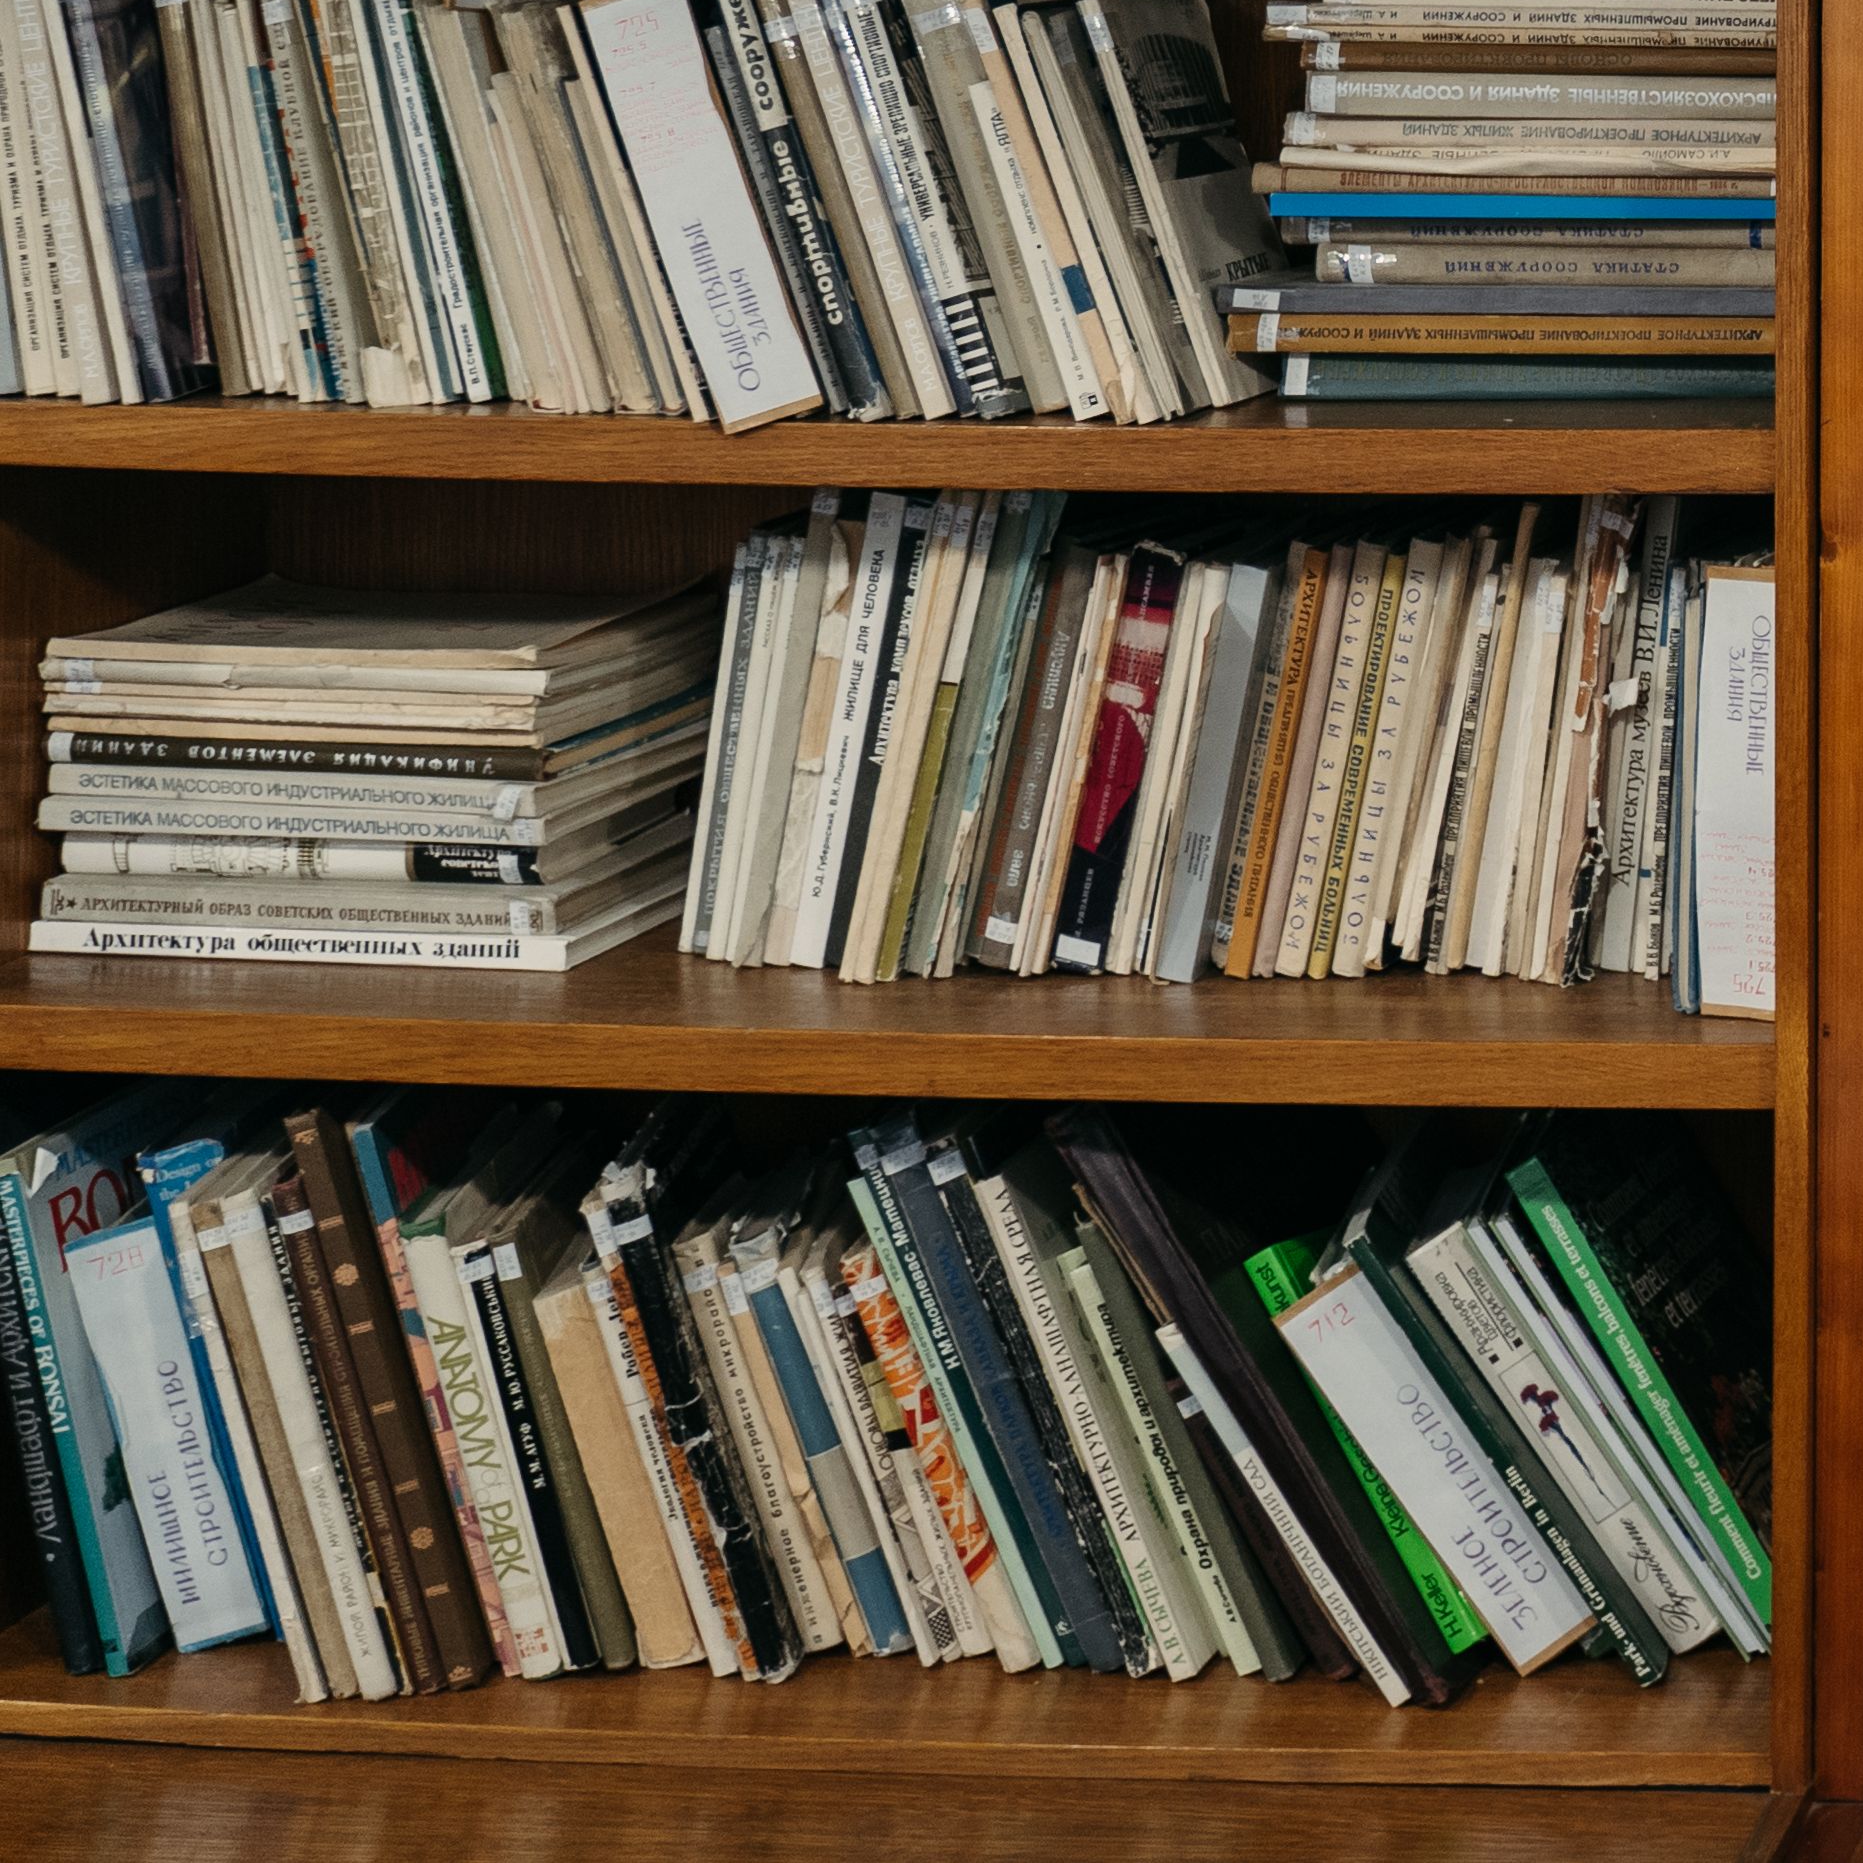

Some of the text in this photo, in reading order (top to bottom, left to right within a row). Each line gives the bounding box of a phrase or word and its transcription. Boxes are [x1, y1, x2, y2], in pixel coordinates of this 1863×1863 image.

[680, 215, 763, 396] ОБЩЕСТВЕННЫЕ
[727, 265, 772, 349] ЗДАНИЯ
[842, 548, 885, 721] ЖИЛИЩЕ ДЛЯ ЧЕЛОВЕКА
[1313, 588, 1394, 954] ПРОЕКТИРОВАНИЕ СОВРЕМЕННЫХ БОЛЬНИЦ
[70, 809, 510, 842] ЭСТЕТИКА МАССОВОГО ИНДУСТРИАЛЬНОГО ЖИЛИЩА
[1612, 748, 1647, 885] Архитектура
[80, 895, 203, 916] АРХИТЕКТУРНЫЙ
[209, 902, 252, 916] ОБРАЗ
[258, 905, 331, 920] СОВЕТСКИХ
[339, 908, 450, 926] ОБЩЕСТВЕННЫХ
[84, 928, 520, 959] Архитектура общественных зданий
[1539, 1203, 1582, 1265] terrasses
[1575, 1263, 1591, 1280] et
[1580, 1277, 1620, 1334] balcons
[0, 1179, 39, 1310] MASTERPIECES
[33, 1344, 70, 1434] BONSAI
[1307, 1302, 1356, 1342] 712
[425, 1308, 530, 1582] ANATOMY PARK
[1644, 1384, 1696, 1457] aménager
[1392, 1374, 1550, 1592] СТРОИТЕЛЬСТВО
[1501, 1464, 1537, 1509] Berlin
[1683, 1452, 1701, 1470] et
[1688, 1467, 1726, 1517] fleurir
[1531, 1508, 1549, 1526] in
[1715, 1512, 1763, 1581] Comment
[1239, 1456, 1389, 1682] НІКІТСЬКИЙ БОТАНІЧНИЙ САД
[1450, 1519, 1539, 1634] ЗЕЛЕНОЕ
[1542, 1524, 1610, 1612] Grünanlagen
[1601, 1611, 1626, 1641] und
